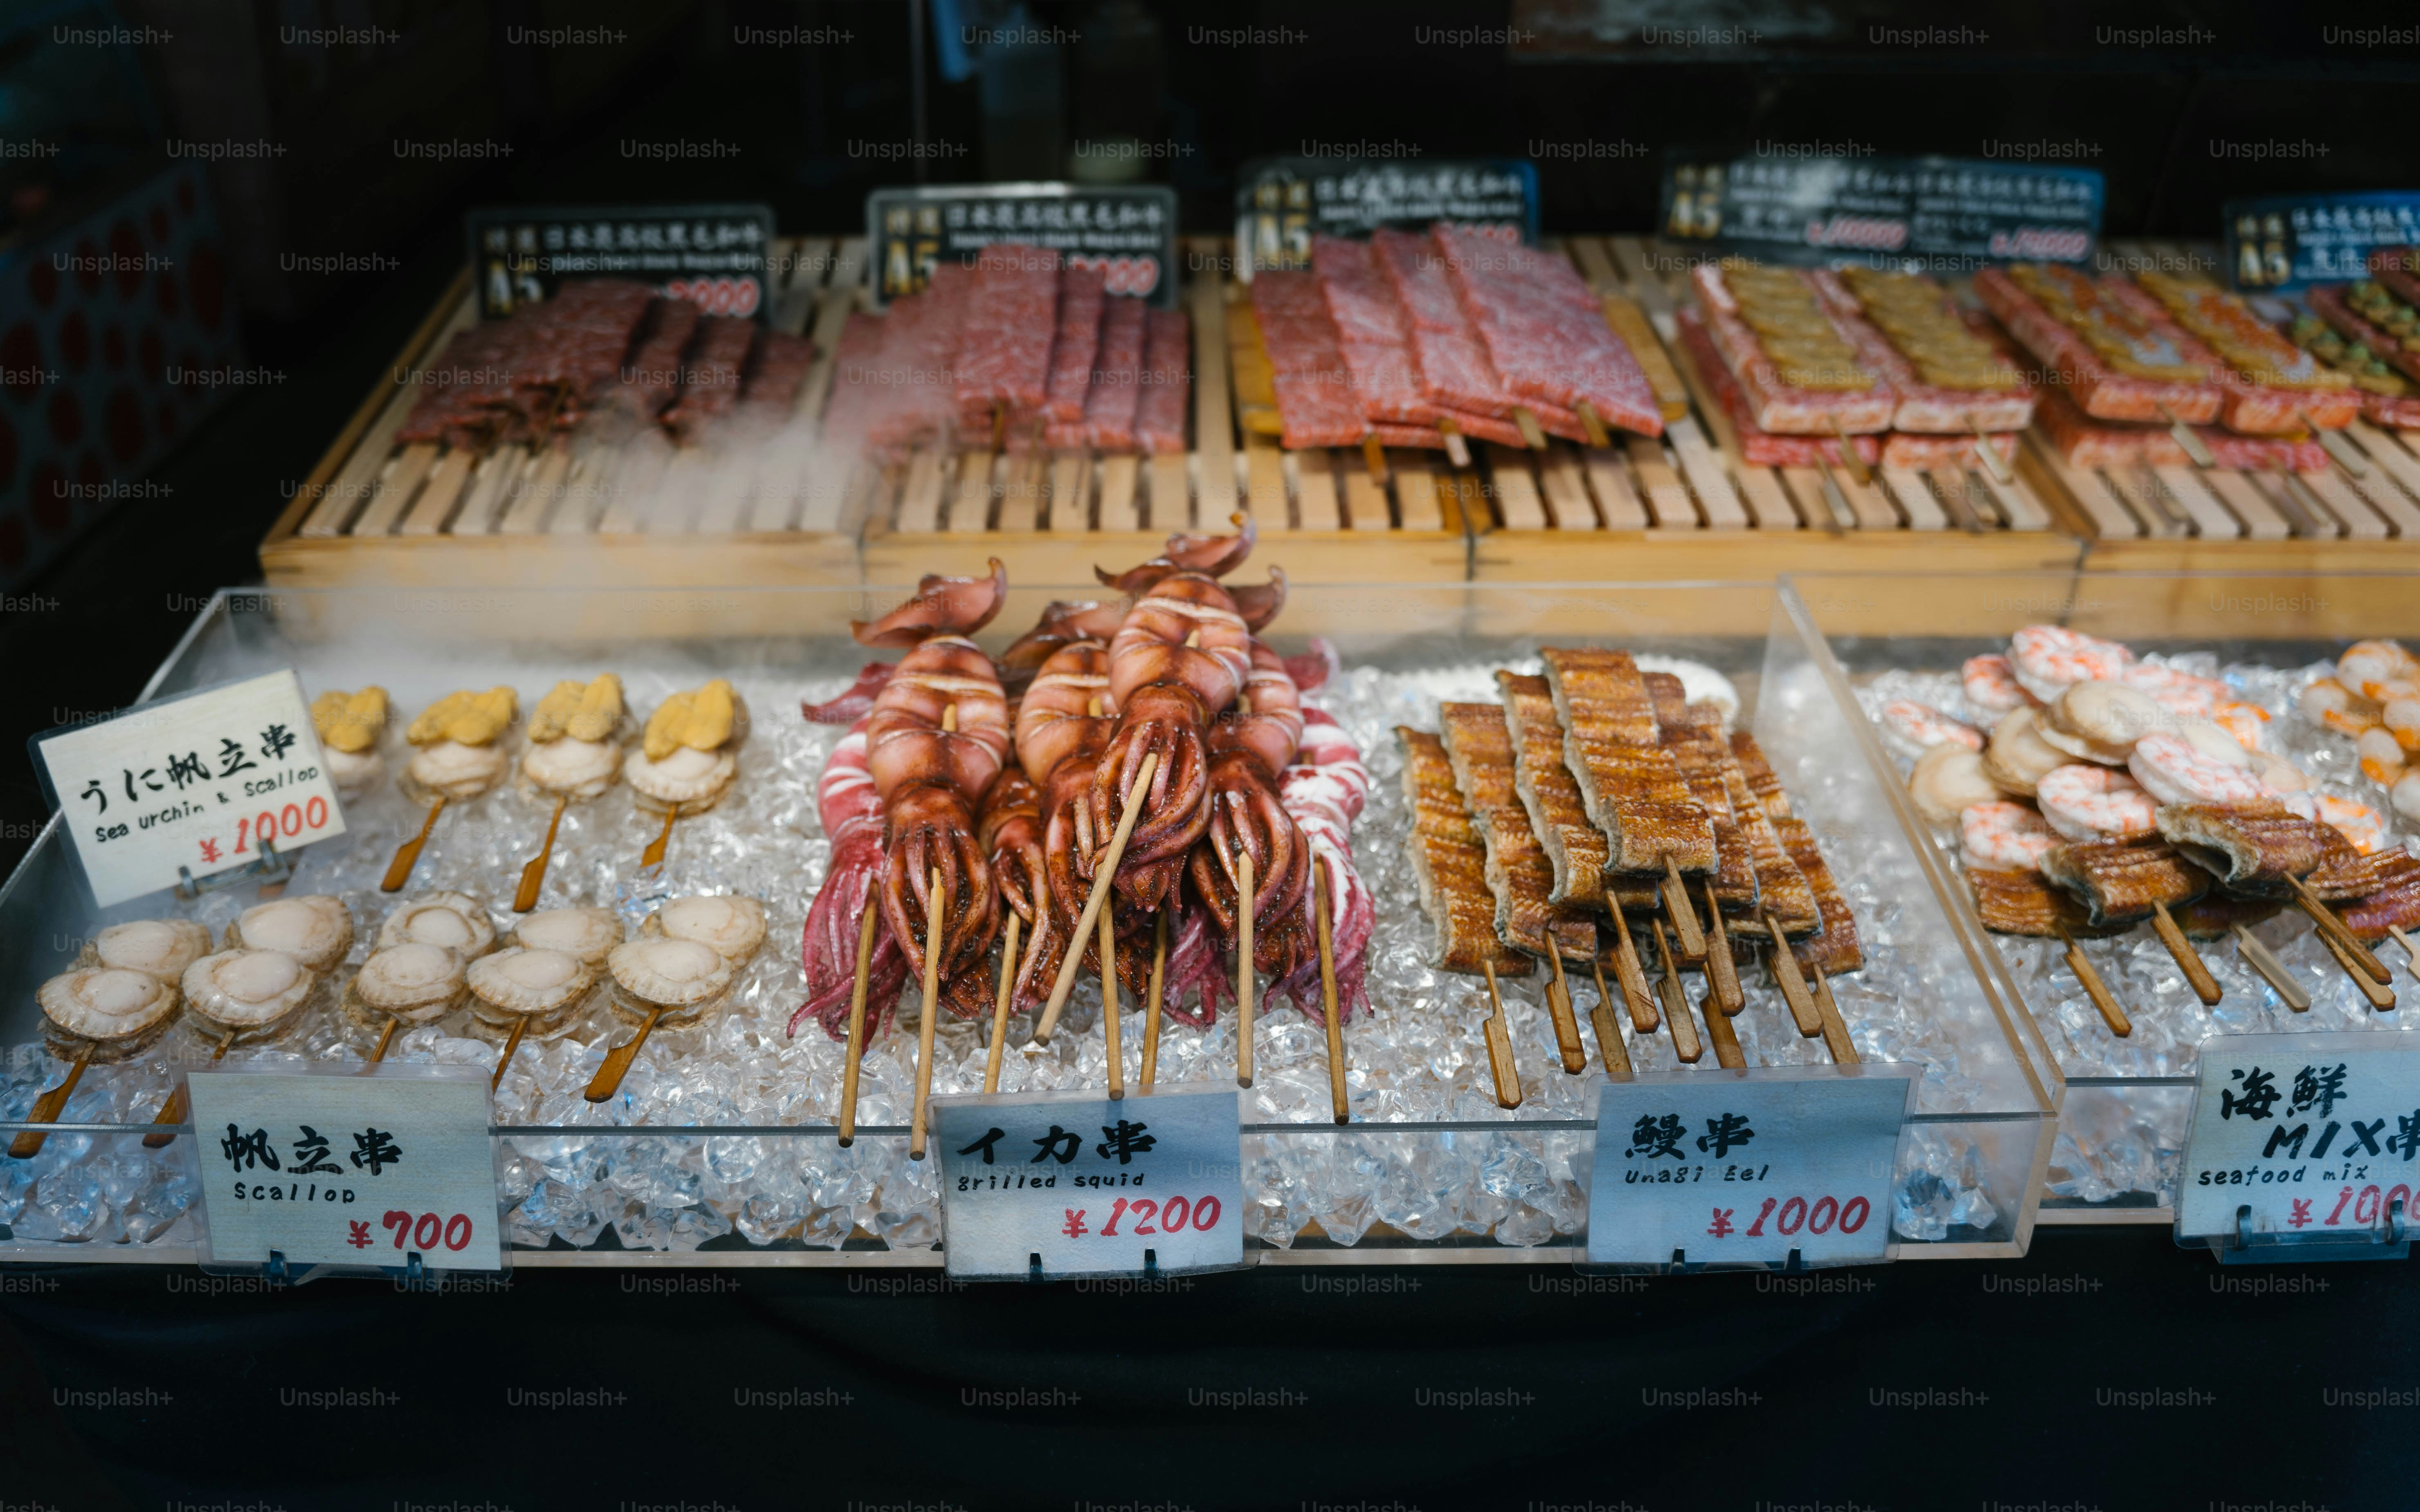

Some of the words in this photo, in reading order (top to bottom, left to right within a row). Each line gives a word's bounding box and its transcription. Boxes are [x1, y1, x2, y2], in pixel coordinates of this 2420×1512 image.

[81, 724, 295, 816] うに帆立串
[216, 791, 229, 804] &
[2221, 1063, 2347, 1121] 海鮮
[221, 1123, 402, 1176] 帆立串
[957, 1119, 1157, 1165] イカ串
[1625, 1112, 1755, 1160] 鰻串
[958, 1175, 1056, 1191] grilled
[1074, 1173, 1144, 1189] squid
[1723, 1164, 1769, 1181] Eel
[2198, 1165, 2307, 1186] seafood
[2323, 1163, 2368, 1182] mix
[1062, 1195, 1221, 1238] ¥1200
[1707, 1195, 1870, 1238] ¥1000
[2288, 1184, 2420, 1228] ¥100
[347, 1210, 473, 1251] ¥700
